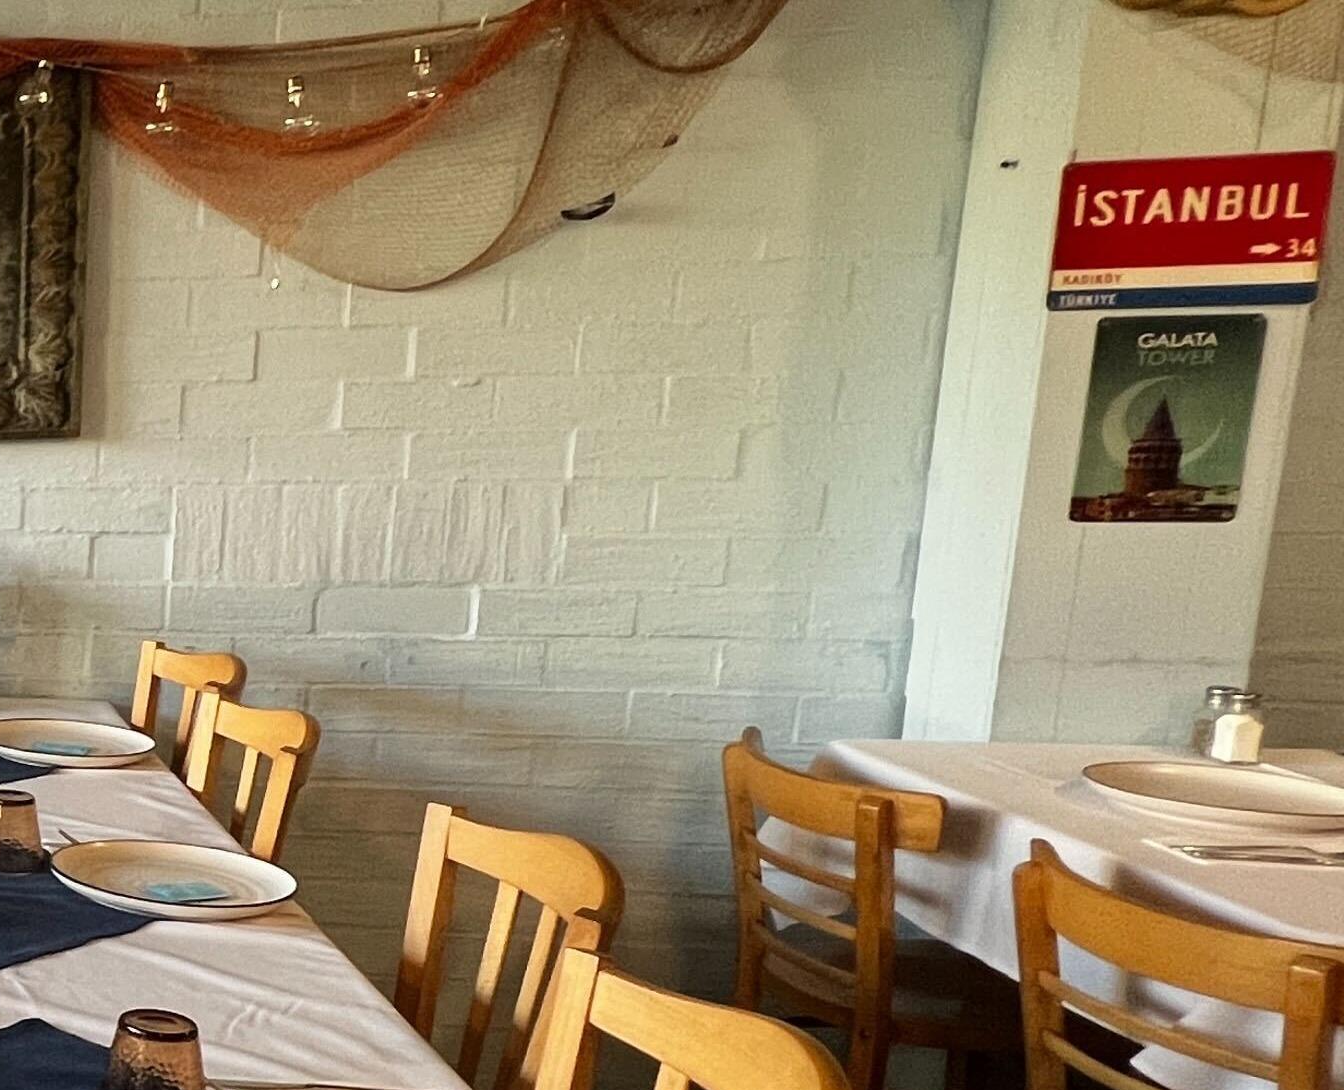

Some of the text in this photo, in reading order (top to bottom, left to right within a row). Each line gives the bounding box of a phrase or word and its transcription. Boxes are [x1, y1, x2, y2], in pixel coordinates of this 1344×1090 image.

[1285, 238, 1317, 258] 34
[1137, 332, 1218, 349] GALATA
[1137, 350, 1216, 367] TOWER
